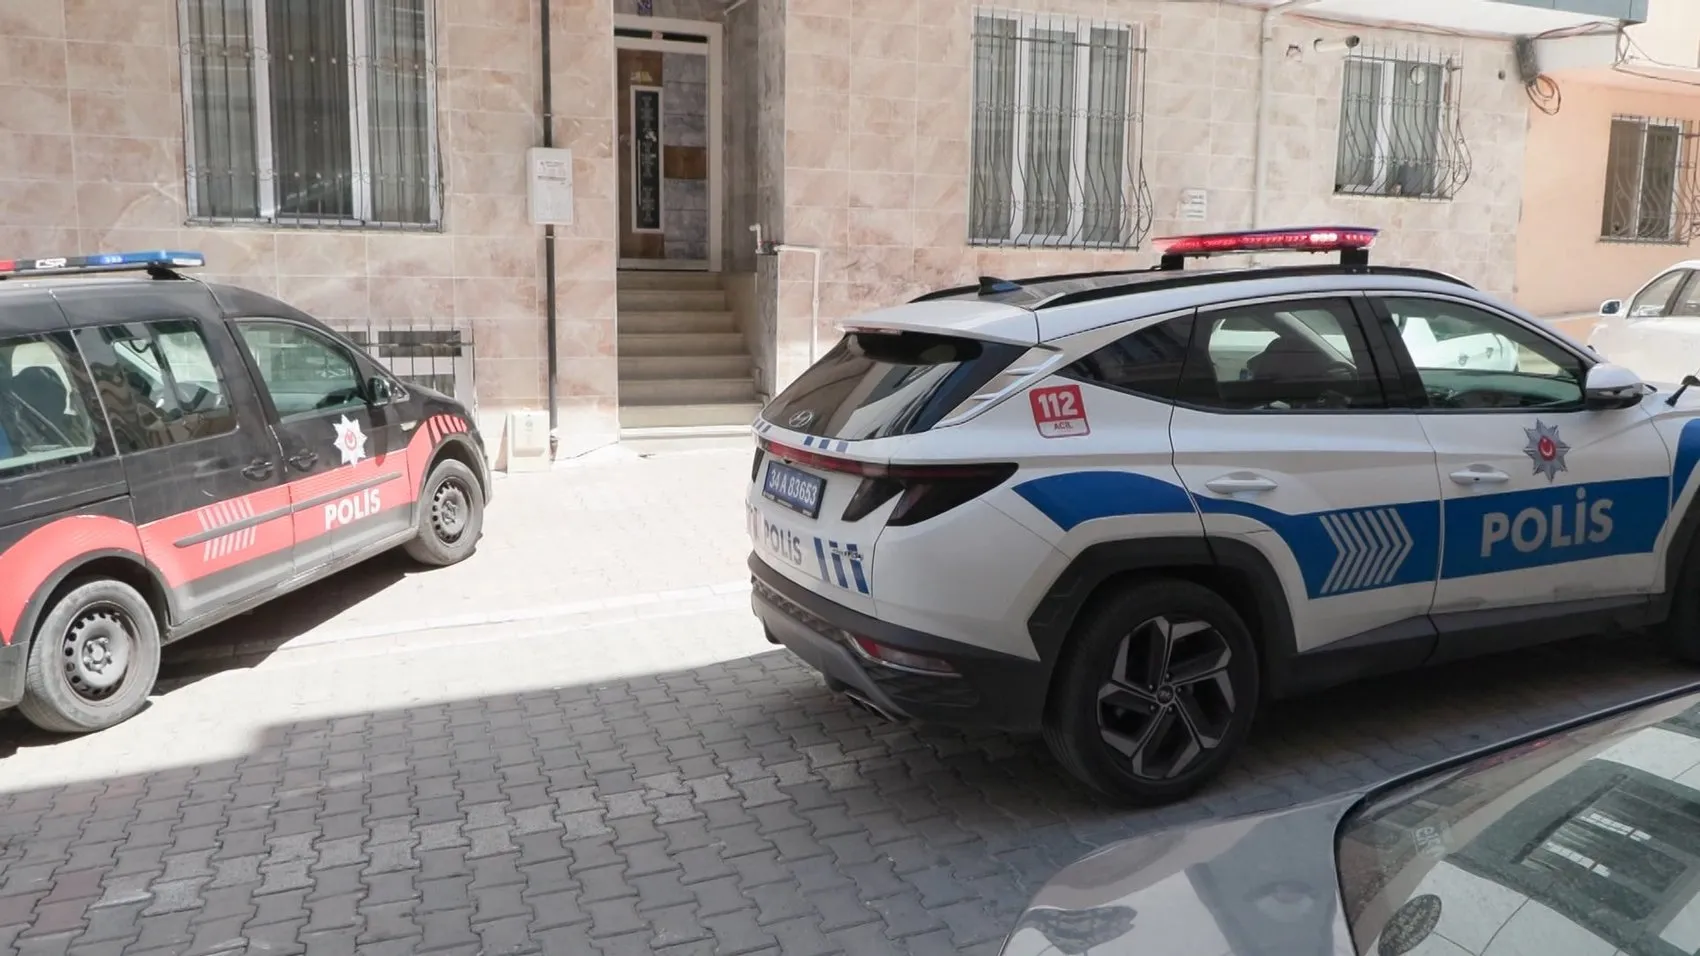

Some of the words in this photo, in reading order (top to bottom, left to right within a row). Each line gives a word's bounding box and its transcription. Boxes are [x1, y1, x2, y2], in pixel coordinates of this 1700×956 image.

[35, 257, 67, 269] CSR
[1038, 391, 1078, 418] 112
[769, 469, 780, 490] 34
[780, 479, 787, 494] A
[787, 477, 818, 507] 83653
[1480, 487, 1614, 557] POLİS
